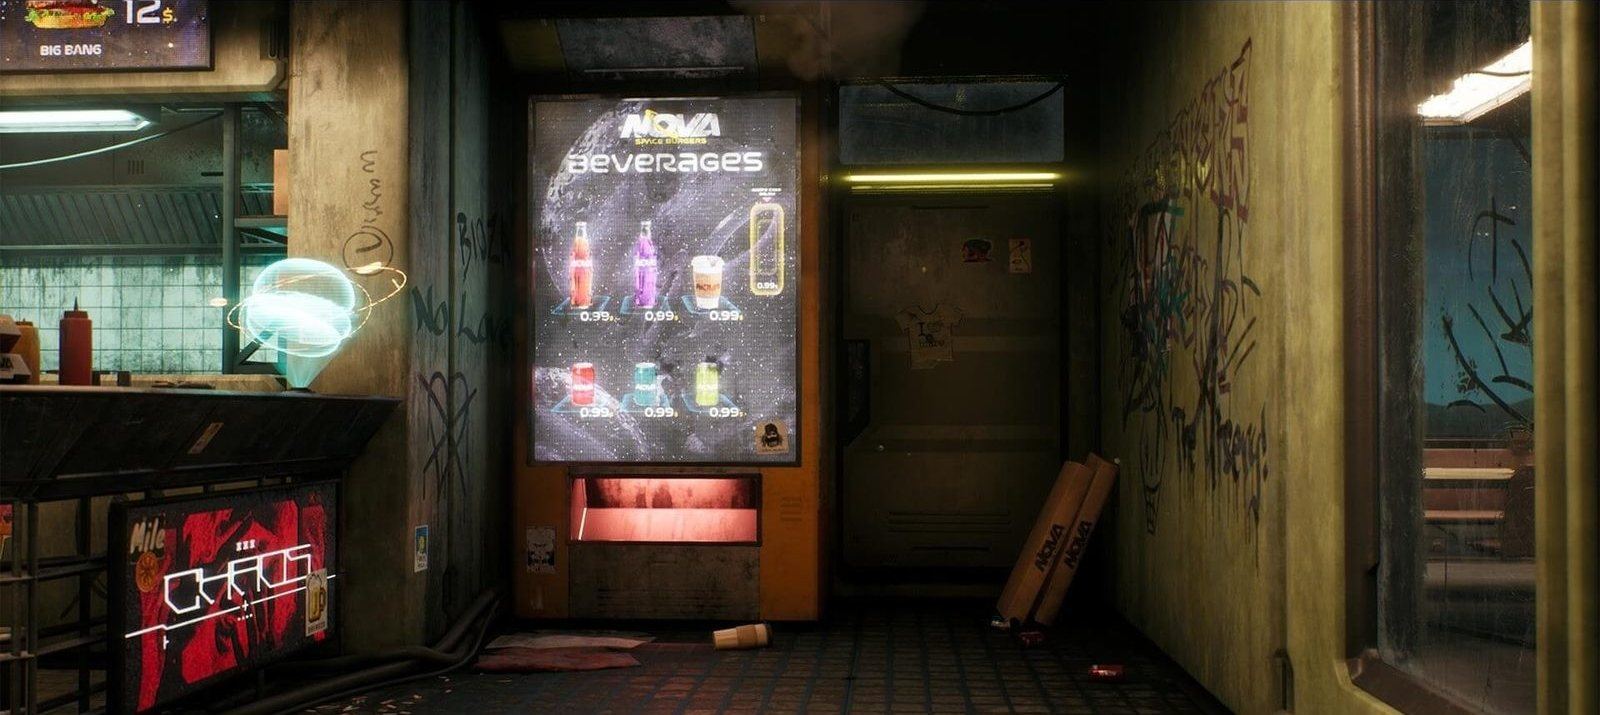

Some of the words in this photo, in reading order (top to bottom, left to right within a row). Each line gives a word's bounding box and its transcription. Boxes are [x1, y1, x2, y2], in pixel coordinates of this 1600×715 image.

[40, 45, 62, 56] BIG
[64, 44, 102, 56] BANG
[619, 112, 720, 138] NOVA
[411, 285, 448, 336] No
[1035, 523, 1066, 572] NOVA
[1063, 520, 1093, 570] NOVA
[164, 543, 312, 614] CHAOS
